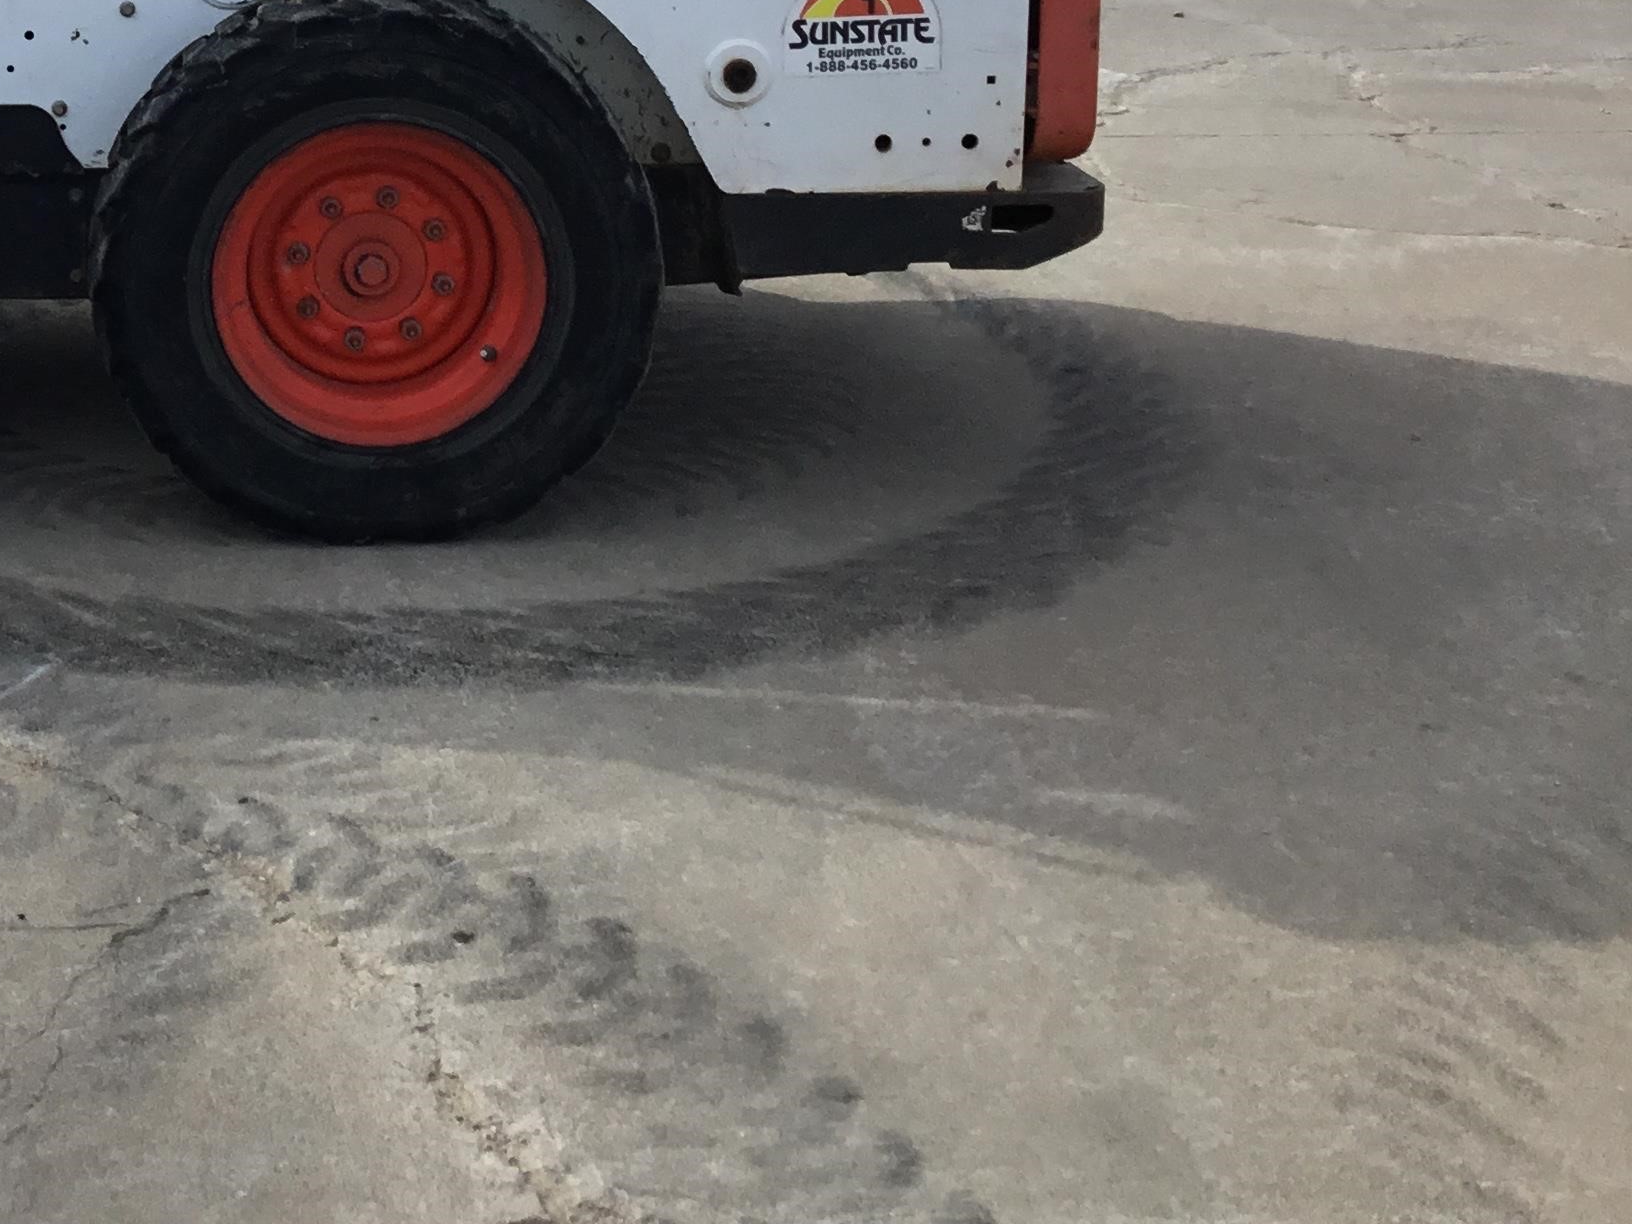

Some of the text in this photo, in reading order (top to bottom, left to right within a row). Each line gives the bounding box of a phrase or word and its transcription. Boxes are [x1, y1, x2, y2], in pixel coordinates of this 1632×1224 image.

[788, 17, 936, 50] SUNSTATE
[818, 44, 906, 61] Equipment Co.
[806, 57, 918, 73] 1-888-456-4560
